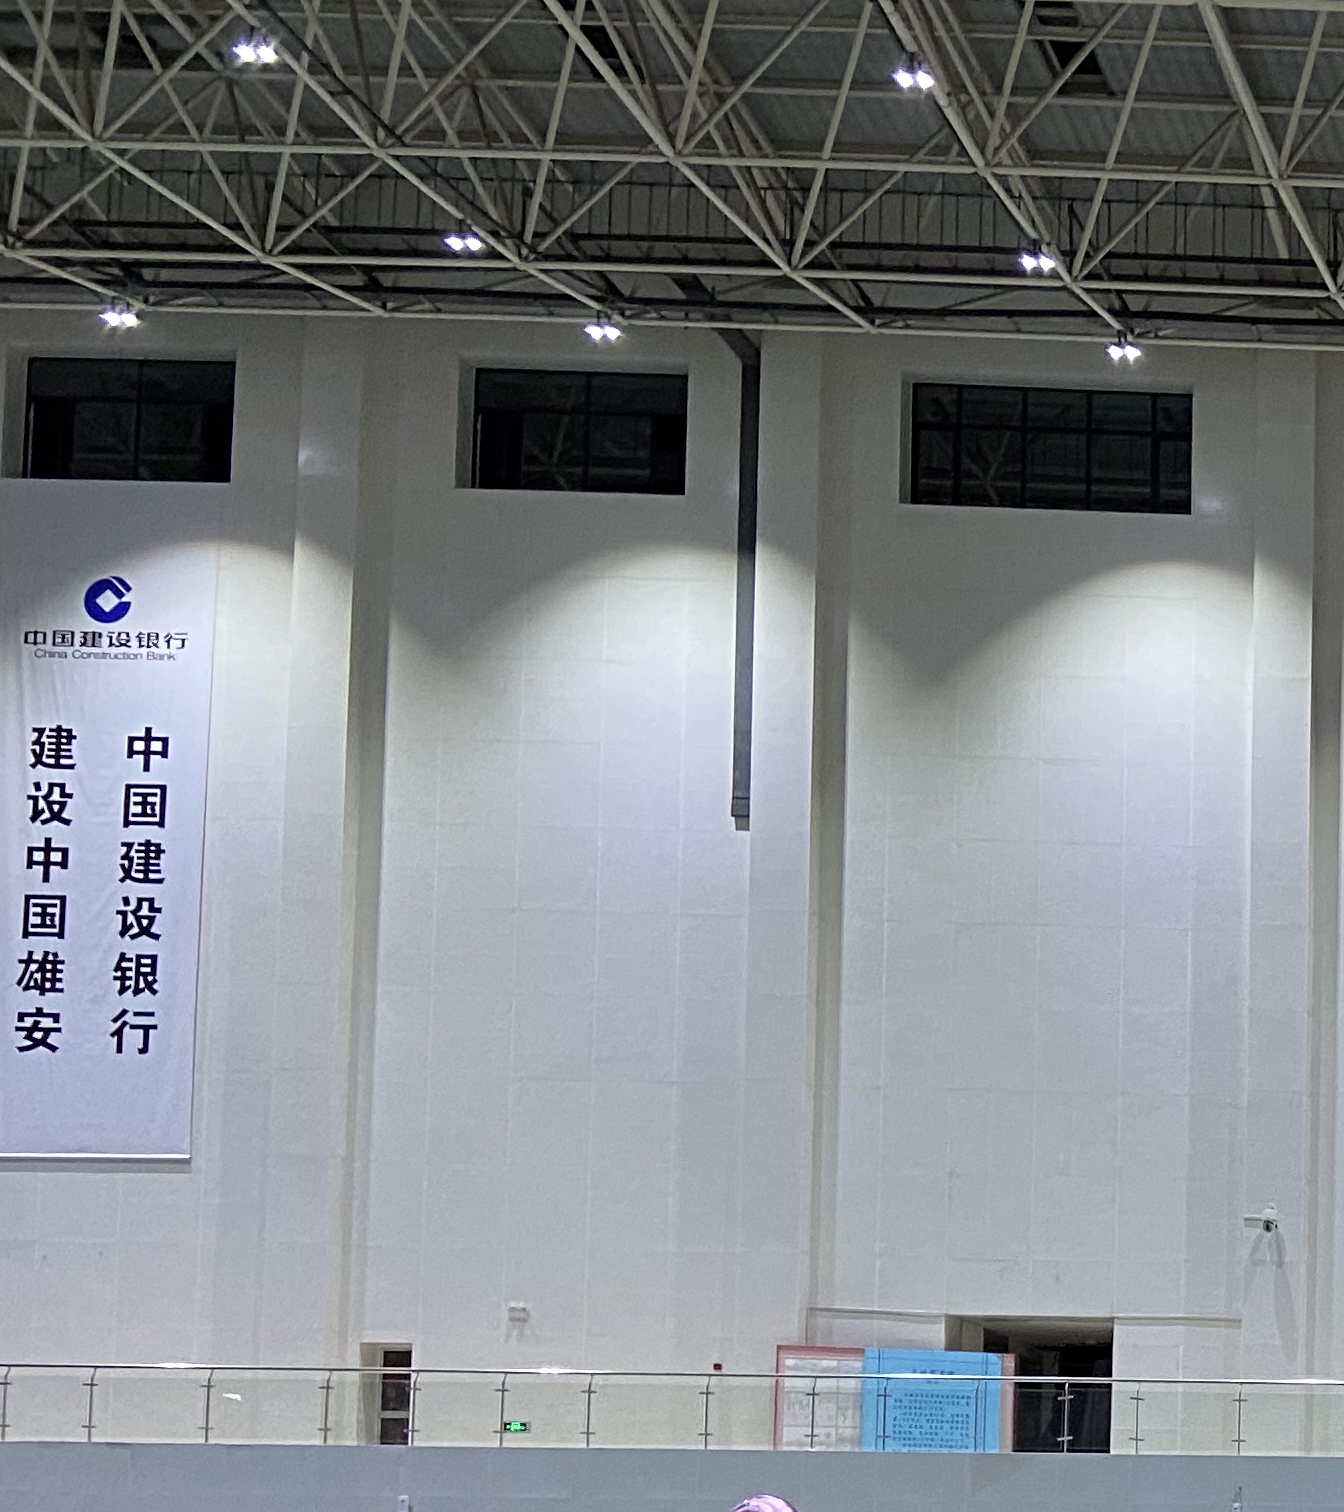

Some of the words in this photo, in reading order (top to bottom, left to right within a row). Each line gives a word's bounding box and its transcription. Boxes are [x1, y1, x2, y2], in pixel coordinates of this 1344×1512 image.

[24, 629, 189, 649] 中国建设银行
[34, 647, 67, 659] China
[72, 648, 143, 661] Construction
[146, 650, 176, 662] Bank
[15, 725, 77, 1053] 建设中国雄安
[110, 727, 169, 1056] 中国建设银行
